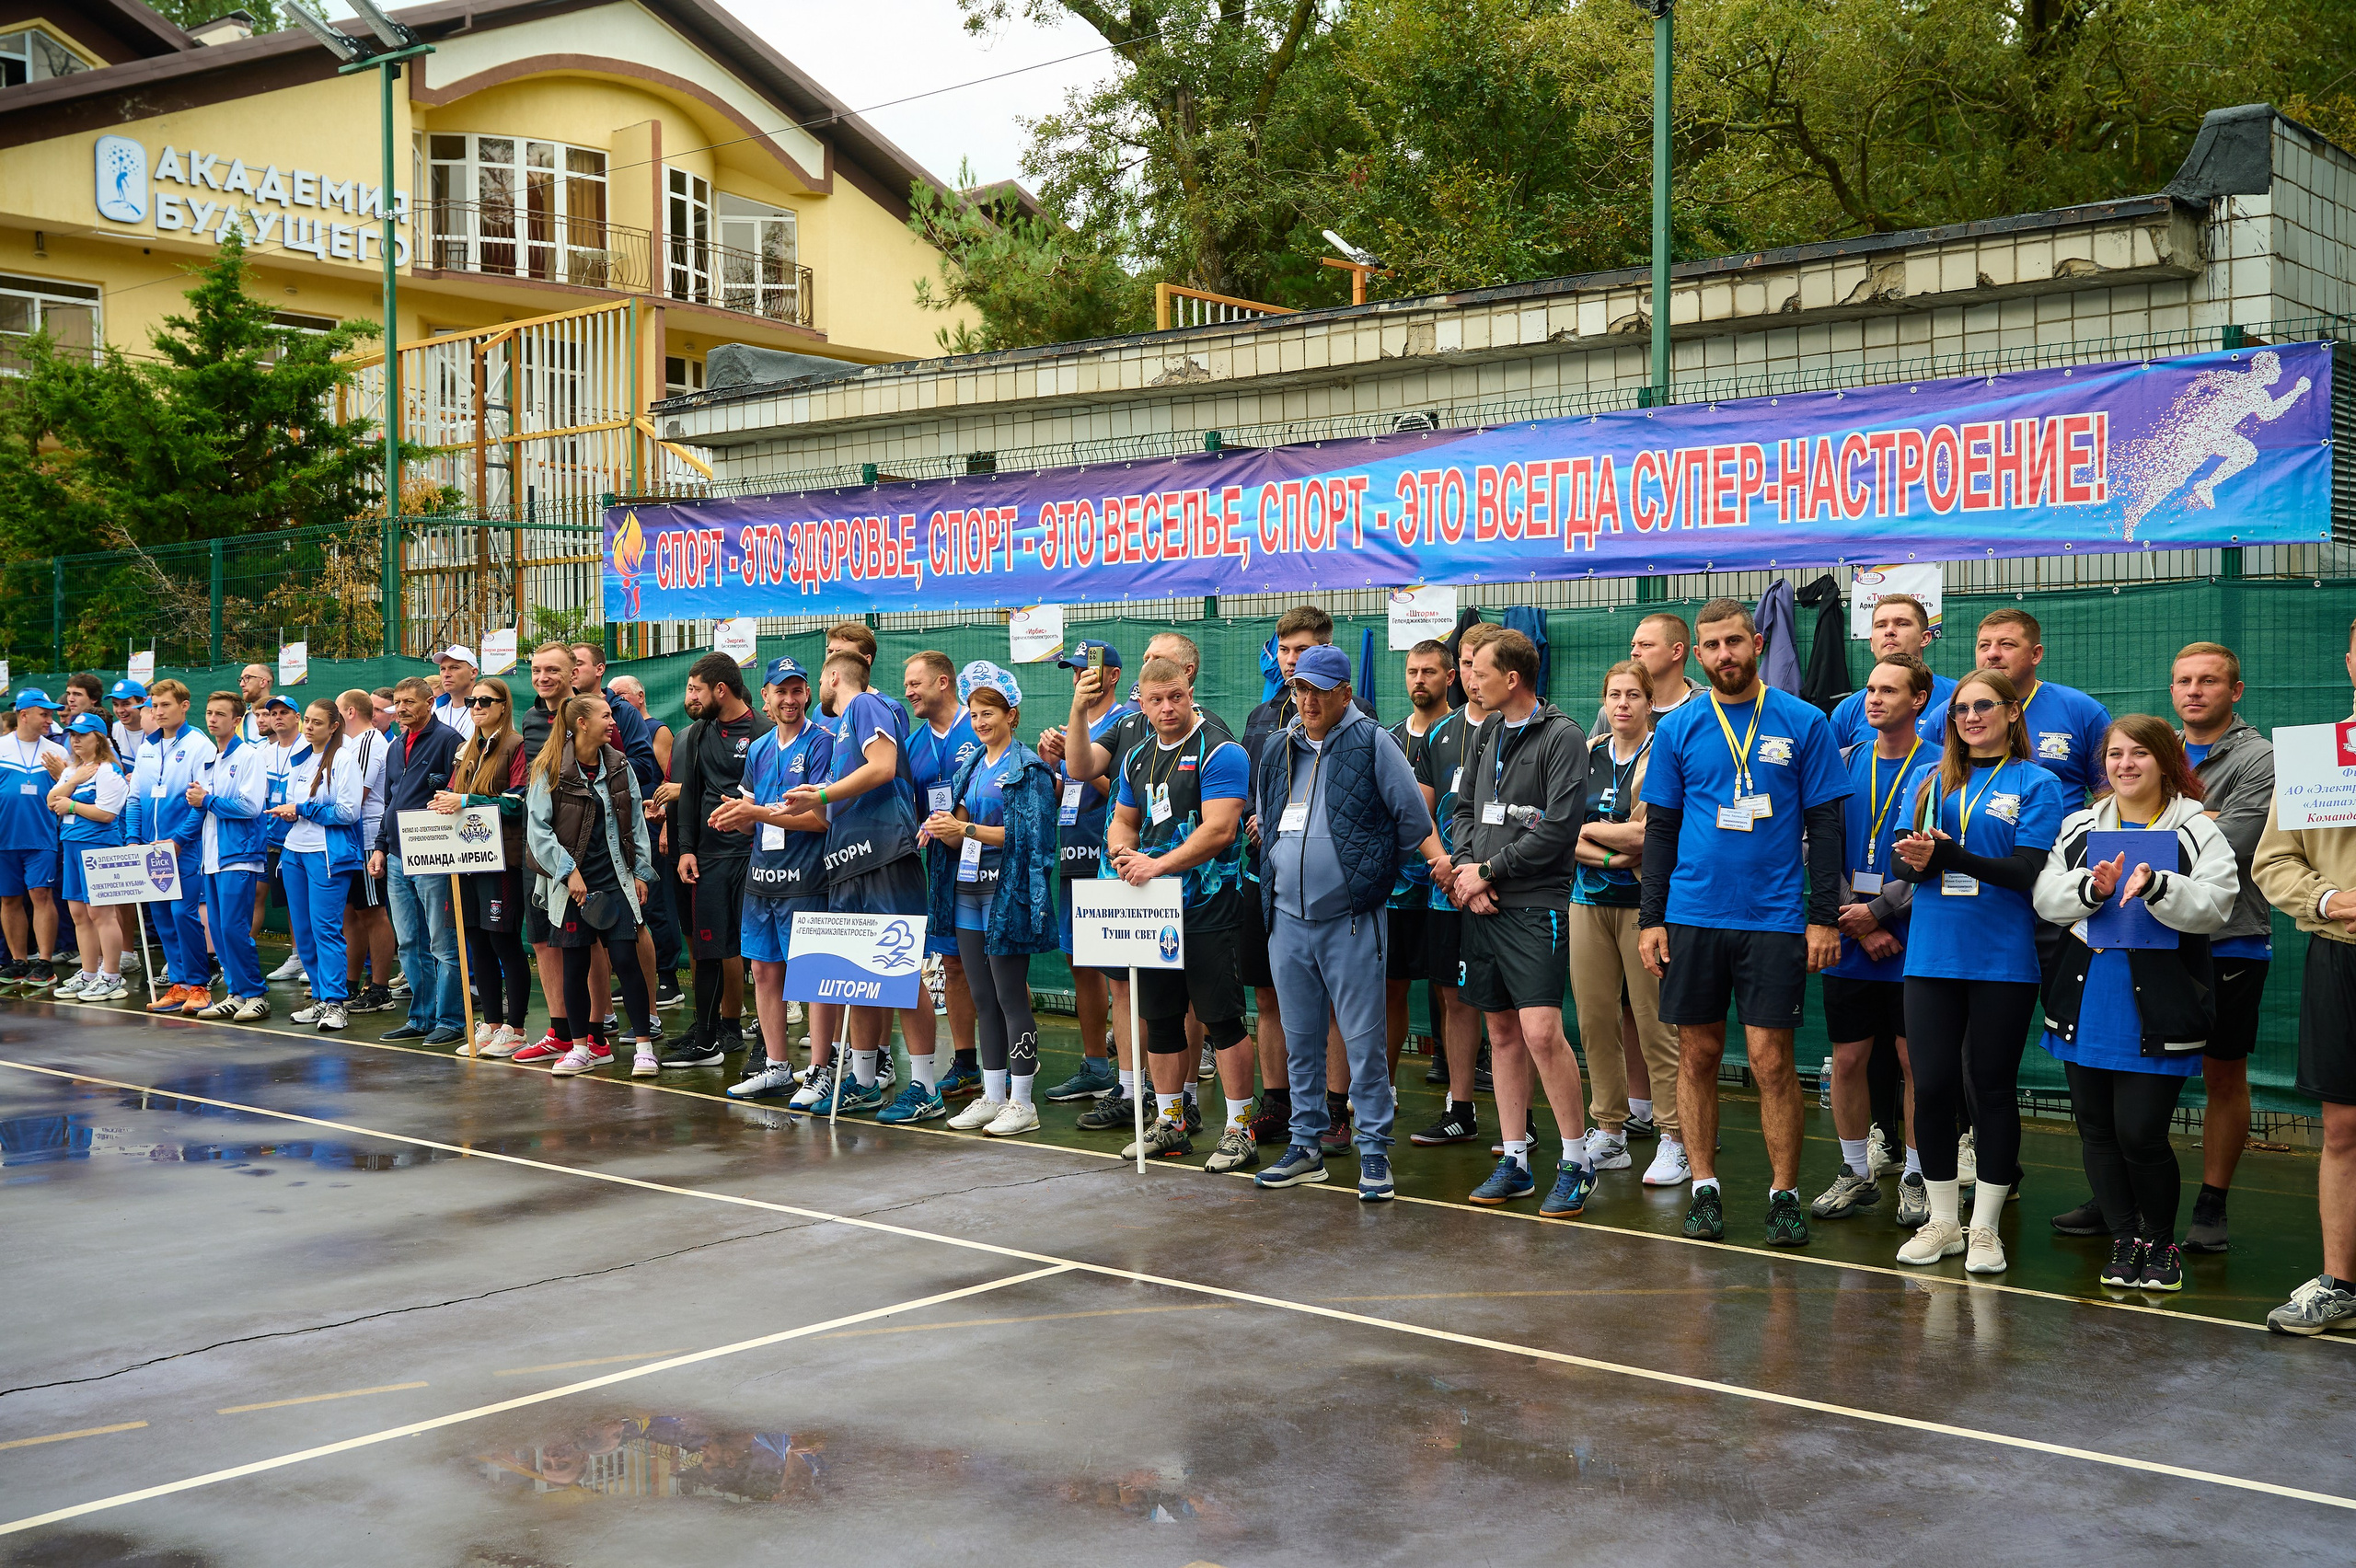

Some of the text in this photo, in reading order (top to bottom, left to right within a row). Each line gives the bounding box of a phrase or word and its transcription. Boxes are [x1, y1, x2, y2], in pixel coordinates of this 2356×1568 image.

[154, 145, 410, 225] АКАДЕМИЯ
[155, 191, 411, 268] БУДУЩЕГО
[655, 527, 726, 591] СПОРТ
[740, 522, 785, 587] ЭТО
[787, 513, 923, 595] ЗДОРОВЬЕ,
[930, 504, 1019, 577] СПОРТ
[1038, 497, 1097, 571] ЭТО
[1103, 484, 1250, 572] ВЕСЕЛЬЕ,
[1257, 473, 1370, 555] СПОРТ
[1394, 466, 1468, 548] ЭТО
[1474, 453, 1622, 553] ВСЕГДА
[1629, 410, 2109, 535] СУПЕР-НАСТРОЕНИЕ!
[1405, 609, 1439, 619] «Шторм»
[2284, 785, 2304, 796] АО
[1598, 787, 1620, 813] 5
[98, 854, 140, 863] ЭЛЕКТРОСЕТИ
[407, 851, 498, 867] КОМАНДА «ИРБИС»
[807, 917, 851, 926] «ЭЛЕКТРОСЕТИ
[851, 918, 878, 927] КУБАНИ»
[796, 927, 877, 937] «ГЕЛЕНДЖИКЭЛЕКТРОСЕТЬ»
[817, 978, 883, 1000] ШТОРМ
